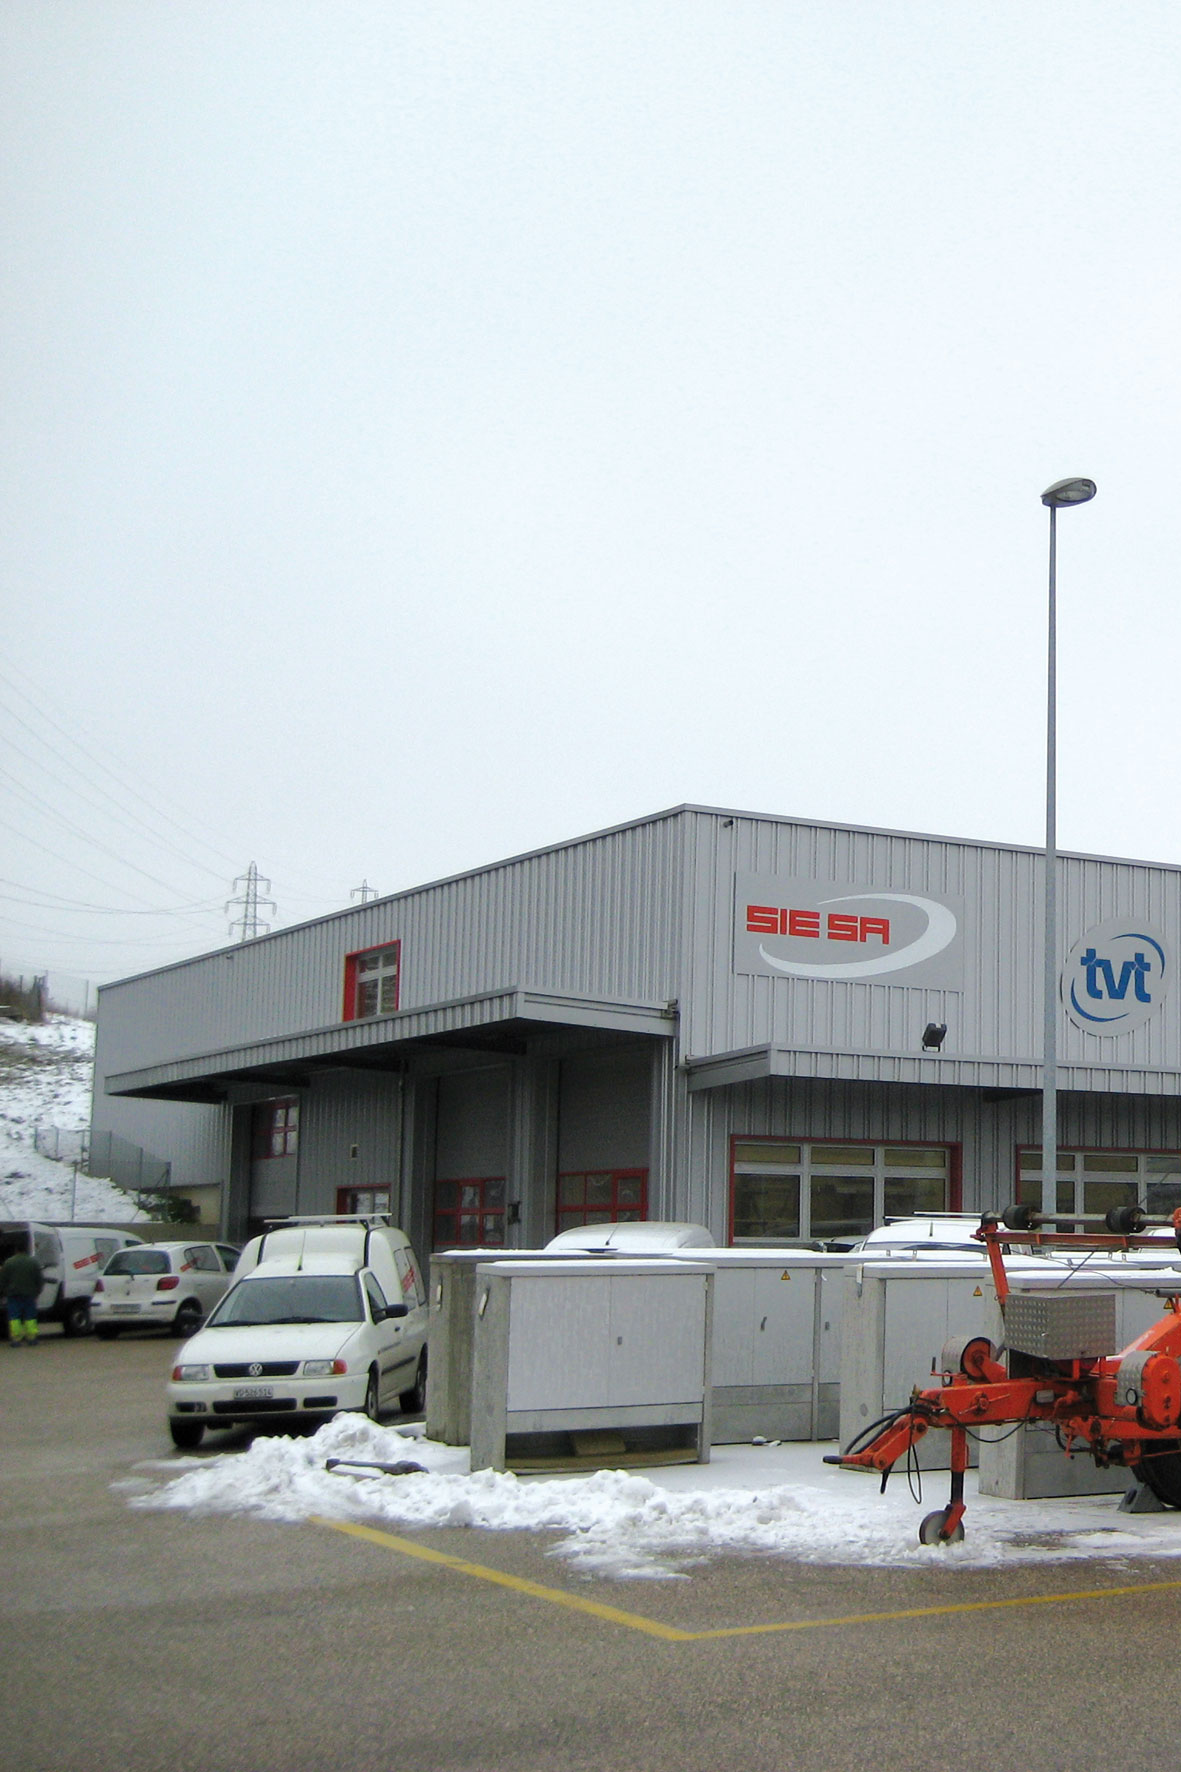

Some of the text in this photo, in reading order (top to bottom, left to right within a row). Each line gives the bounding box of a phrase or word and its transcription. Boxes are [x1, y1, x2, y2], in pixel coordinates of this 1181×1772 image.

[747, 905, 889, 944] SIE SA
[1081, 948, 1152, 1003] tvt
